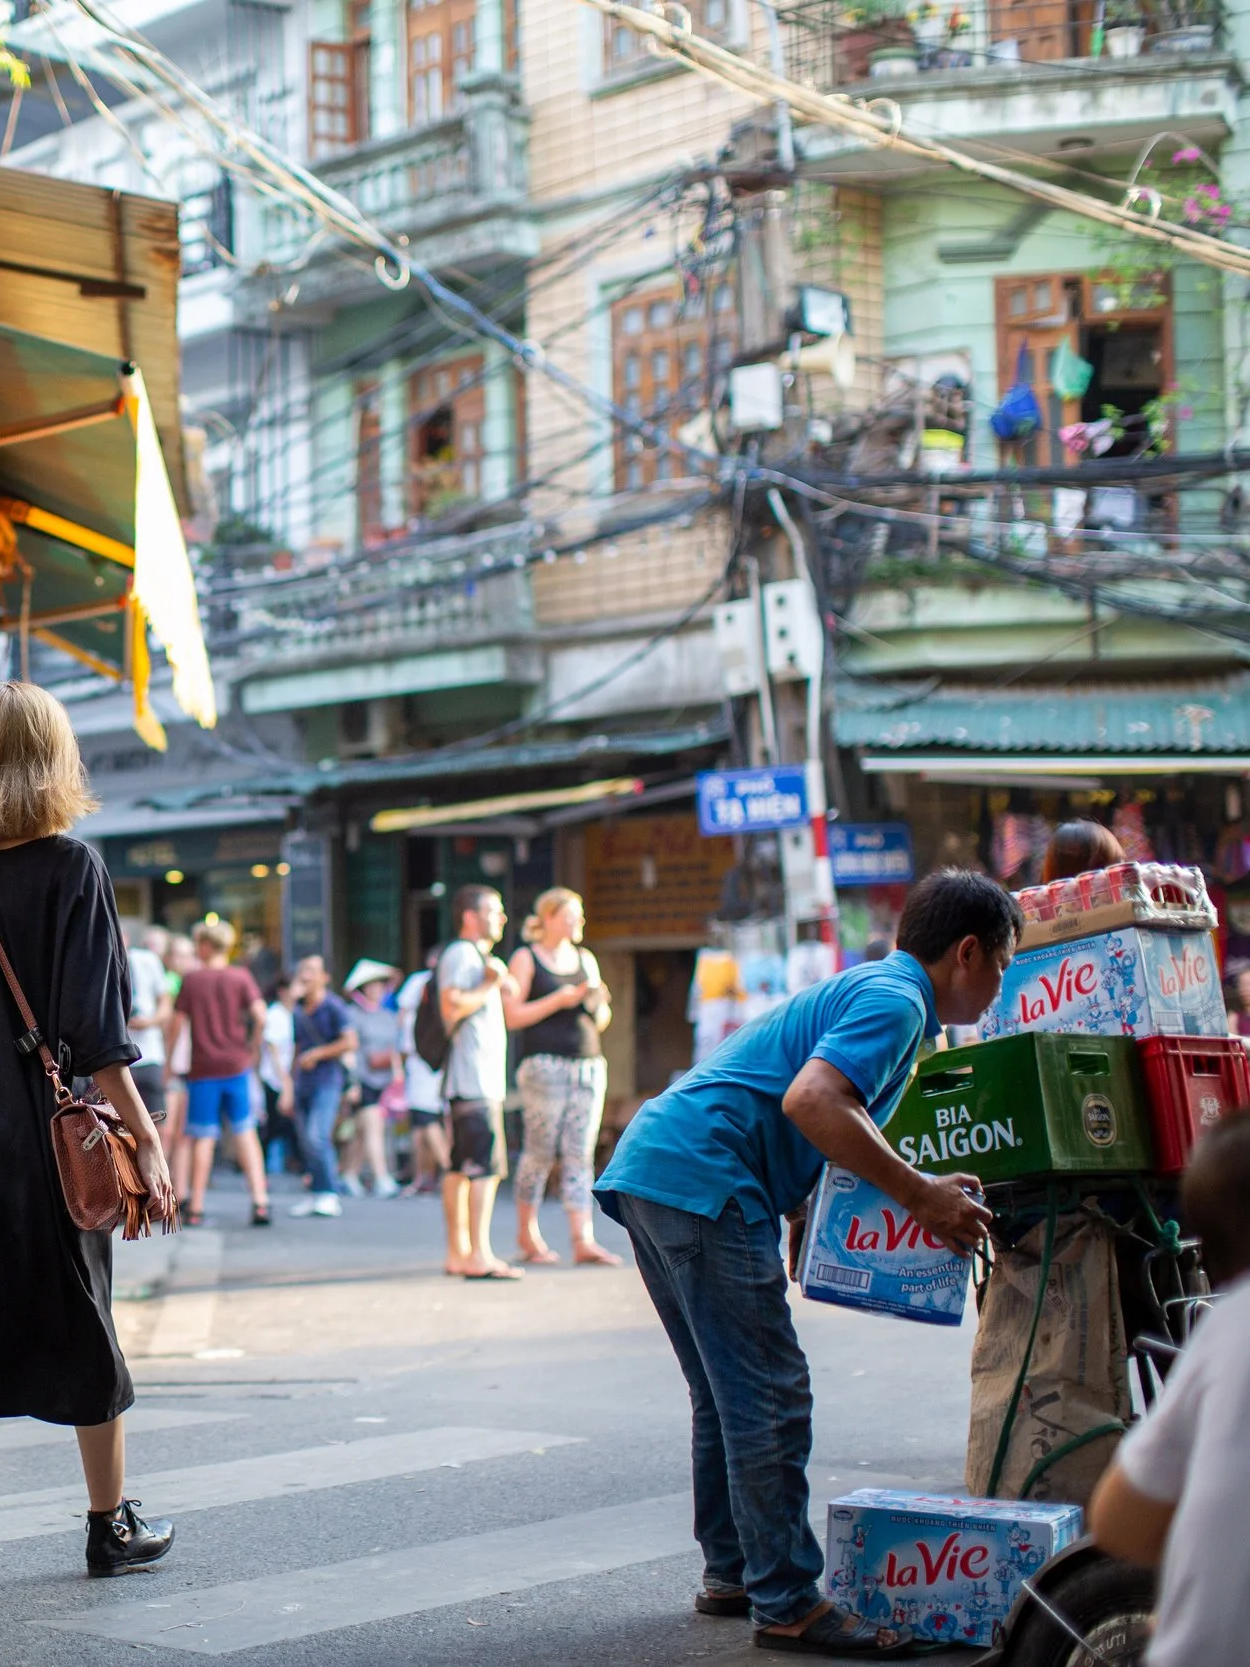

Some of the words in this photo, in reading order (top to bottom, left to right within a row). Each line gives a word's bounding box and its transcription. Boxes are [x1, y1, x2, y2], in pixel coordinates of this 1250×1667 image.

[935, 1104, 973, 1128] BIA
[899, 1117, 1016, 1166] SAIGON
[899, 1267, 914, 1278] An
[916, 1261, 965, 1278] essential
[901, 1282, 924, 1294] part
[925, 1280, 938, 1292] of
[938, 1276, 957, 1289] life
